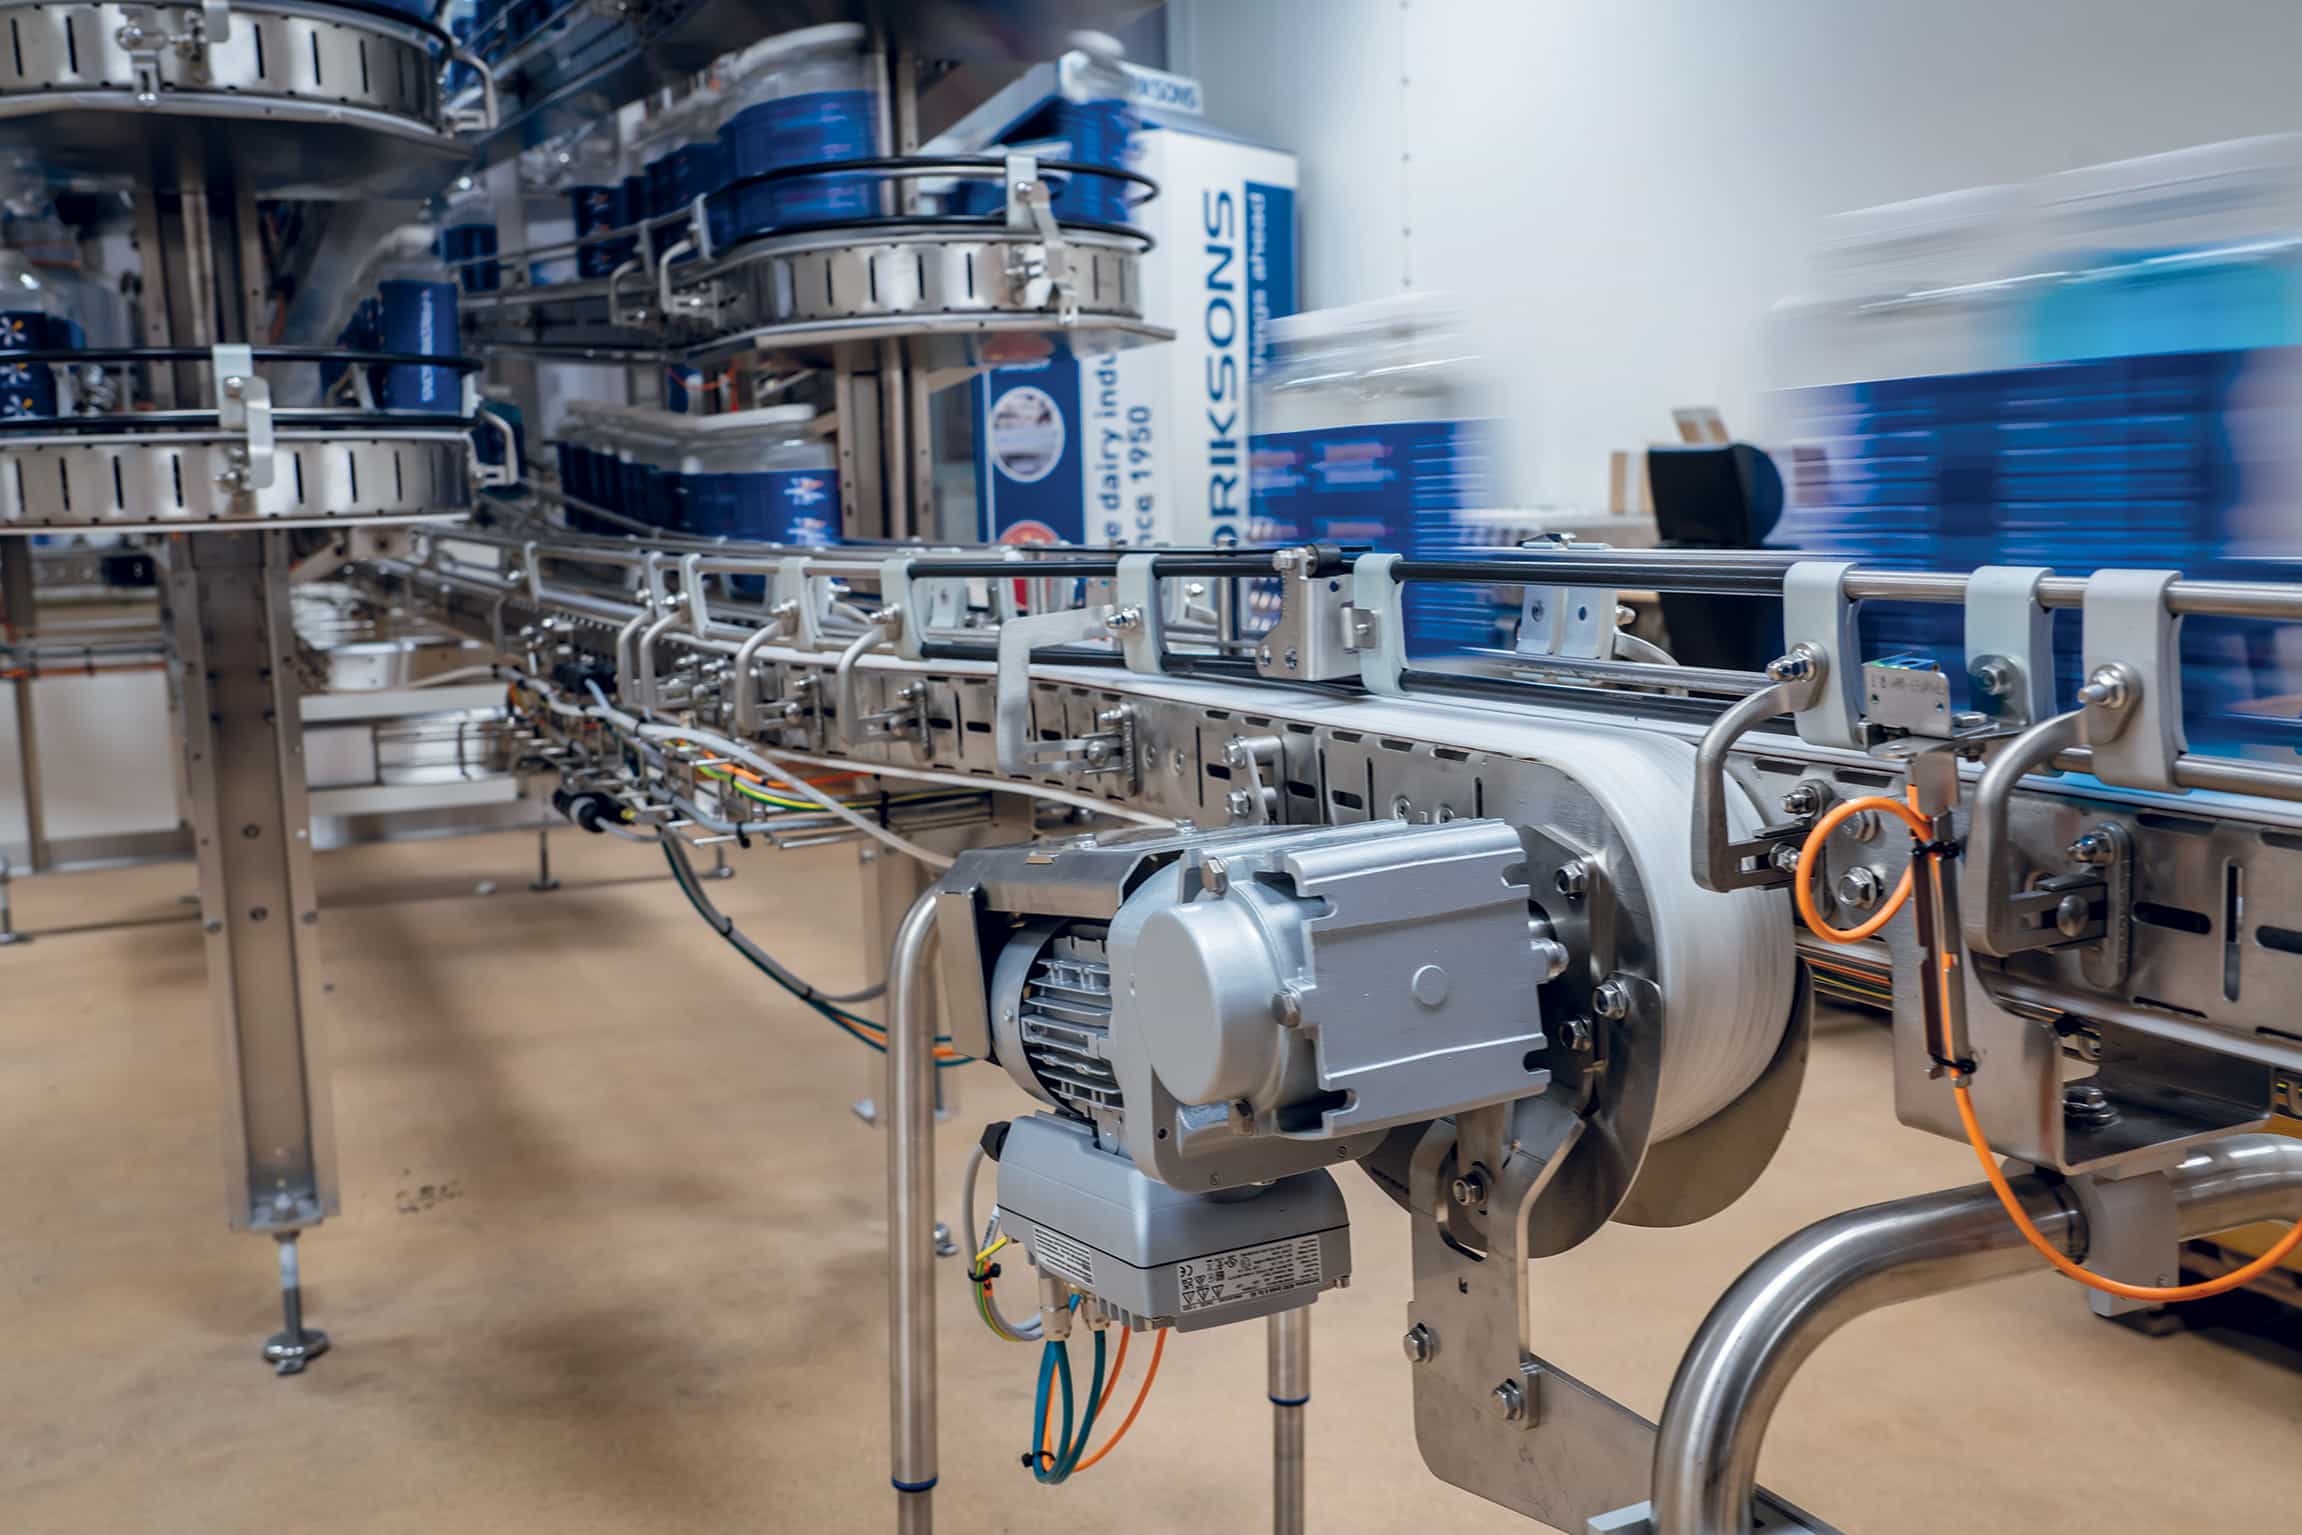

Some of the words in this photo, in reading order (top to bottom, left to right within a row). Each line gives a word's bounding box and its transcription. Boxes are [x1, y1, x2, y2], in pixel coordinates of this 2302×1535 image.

[1249, 192, 1267, 281] ahead
[1098, 429, 1123, 511] dairy
[1127, 405, 1152, 482] 1950
